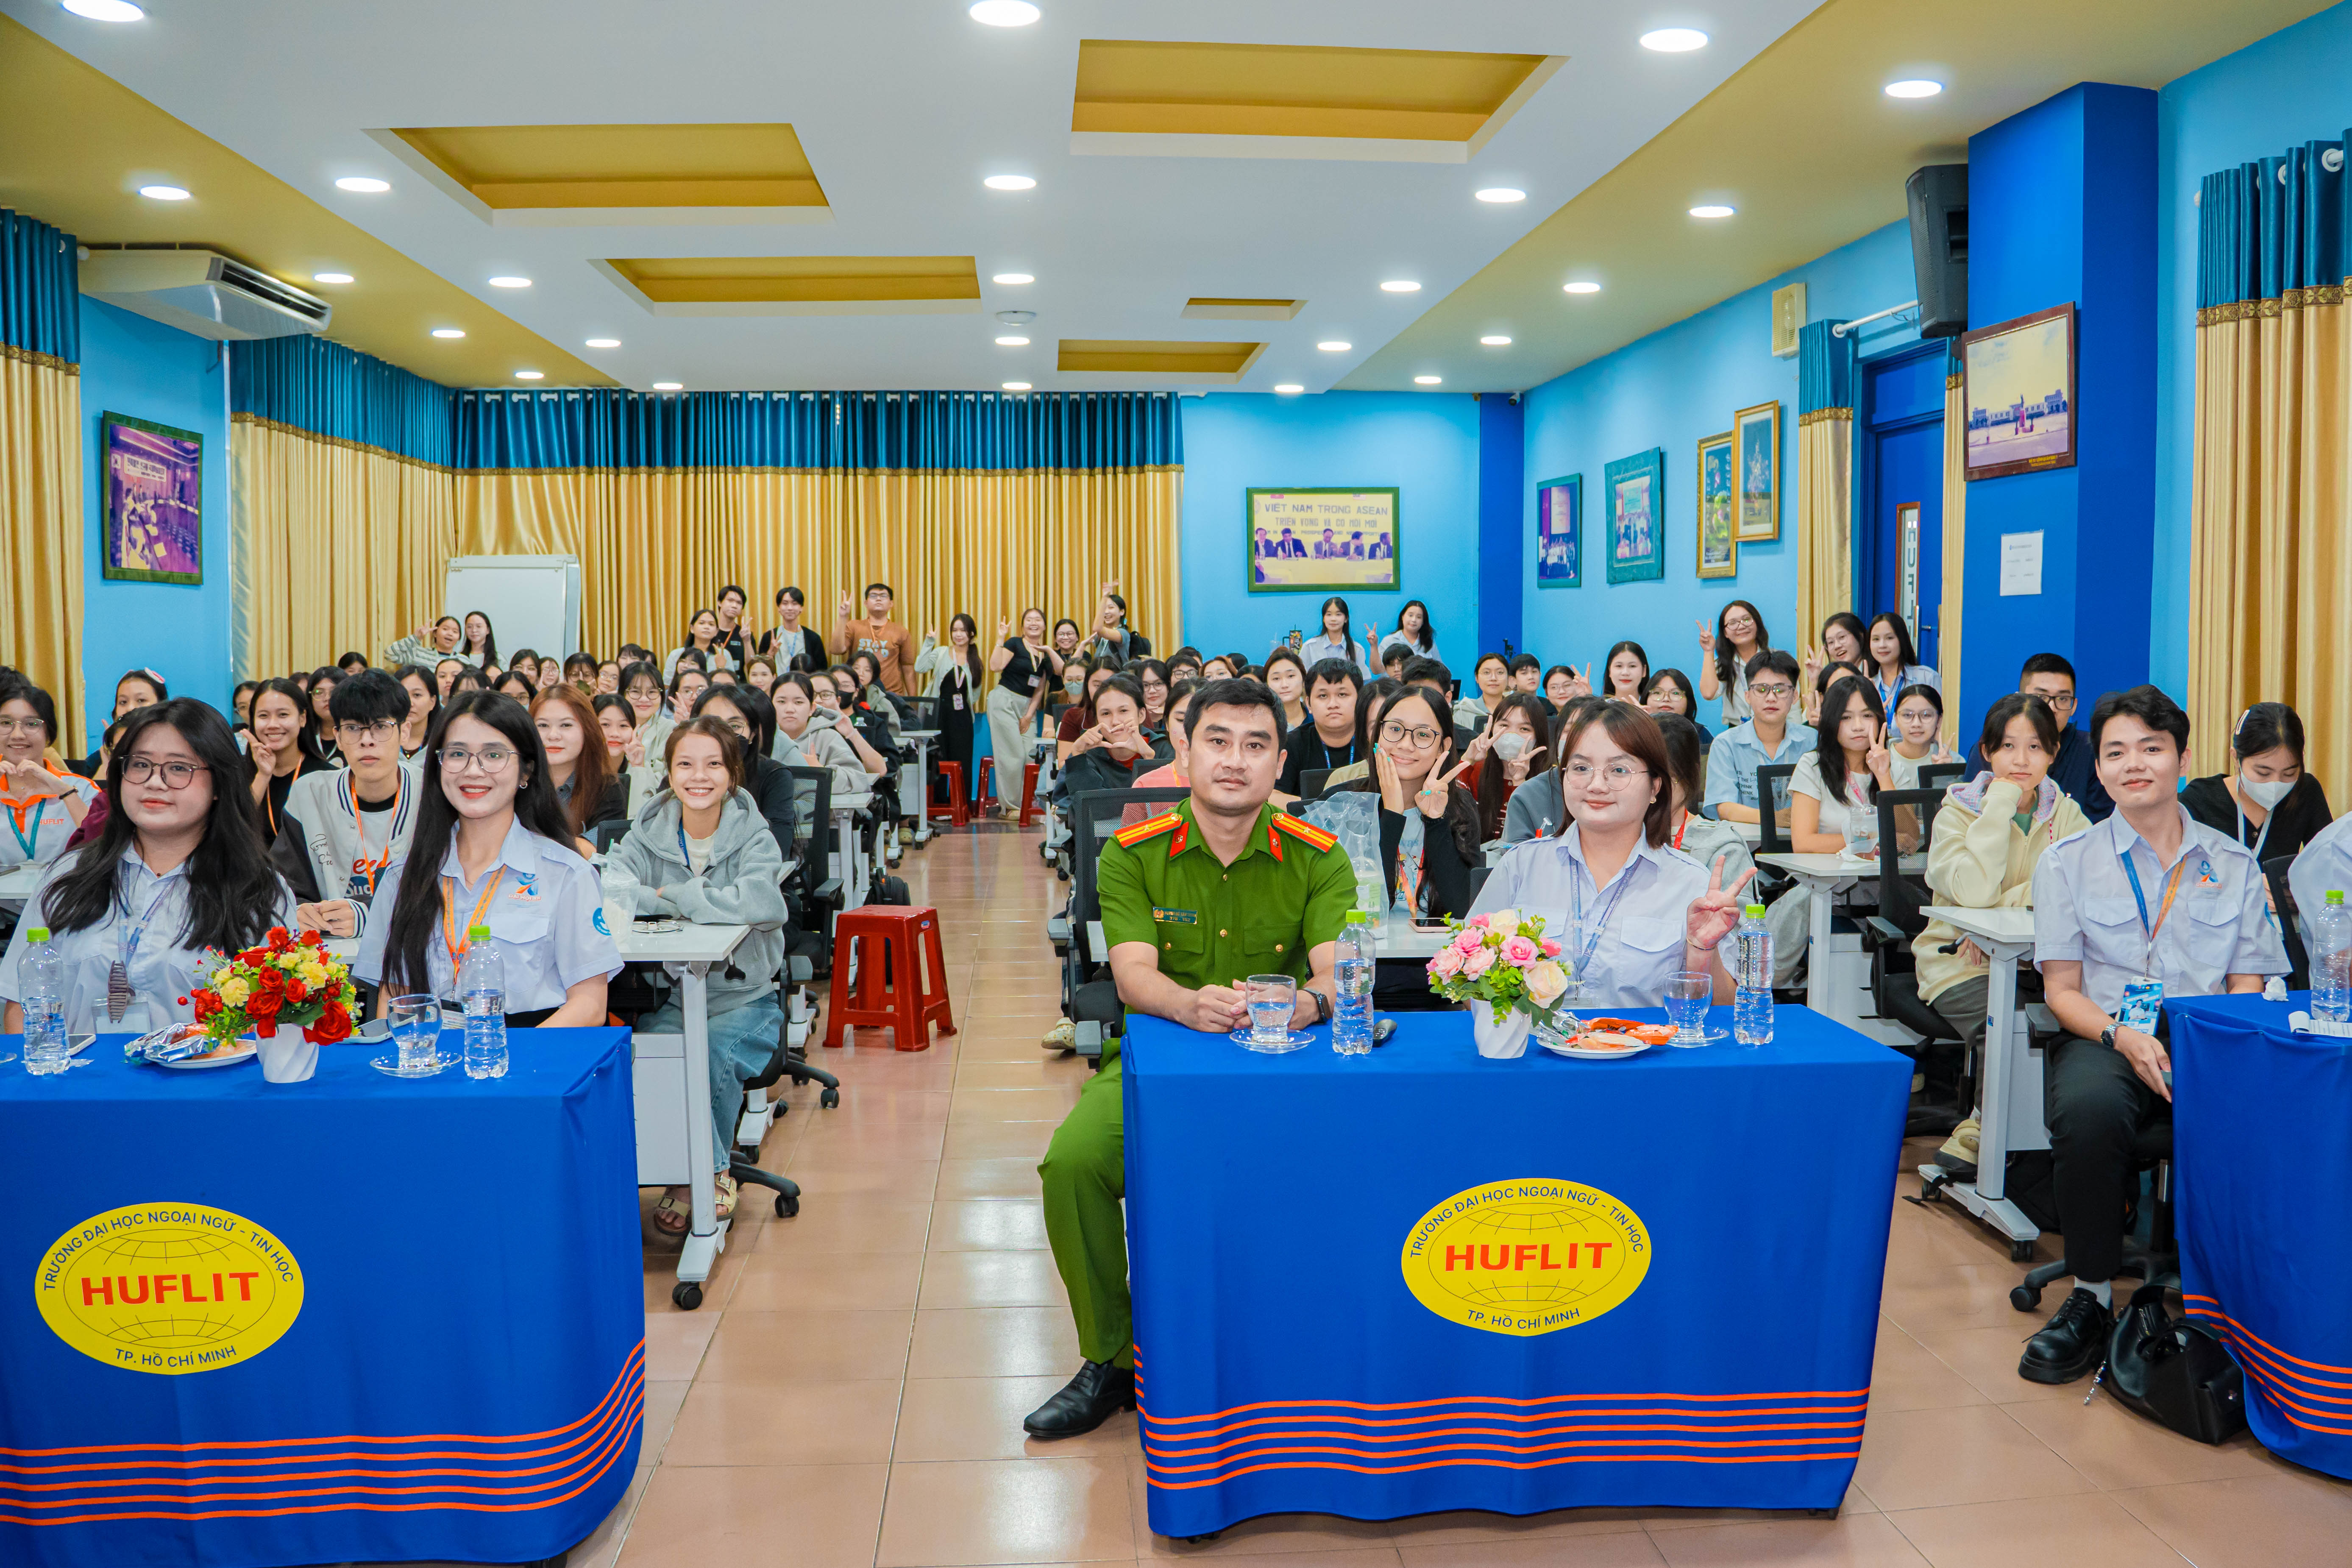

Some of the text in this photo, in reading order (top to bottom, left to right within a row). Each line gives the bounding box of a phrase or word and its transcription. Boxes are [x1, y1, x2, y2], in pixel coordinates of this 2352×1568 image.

[1357, 506, 1388, 515] ASEAN
[859, 638, 888, 649] STAY
[1410, 1209, 1453, 1258] TRƯỜNG
[1454, 1195, 1479, 1210] ĐẠI
[1483, 1188, 1514, 1203] HỌC
[1519, 1186, 1563, 1199] NGOẠI
[1567, 1189, 1599, 1206] NGỮ
[1609, 1206, 1629, 1226] TIN
[1624, 1224, 1643, 1252] HỌC
[44, 1237, 83, 1291] TRƯỜNG
[83, 1223, 109, 1238] ĐẠI
[110, 1213, 144, 1230] HỌC
[148, 1211, 196, 1224] NGOẠI
[201, 1214, 237, 1231] NGỮ
[251, 1231, 273, 1253] TIN
[269, 1251, 294, 1282] HỌC
[1445, 1242, 1612, 1271] HUFLIT
[81, 1272, 259, 1306] HUFLIT
[1468, 1308, 1580, 1329] TP. HỒ CHÍ MINH
[115, 1345, 237, 1367] TP. HỒ CHÍ MINH
